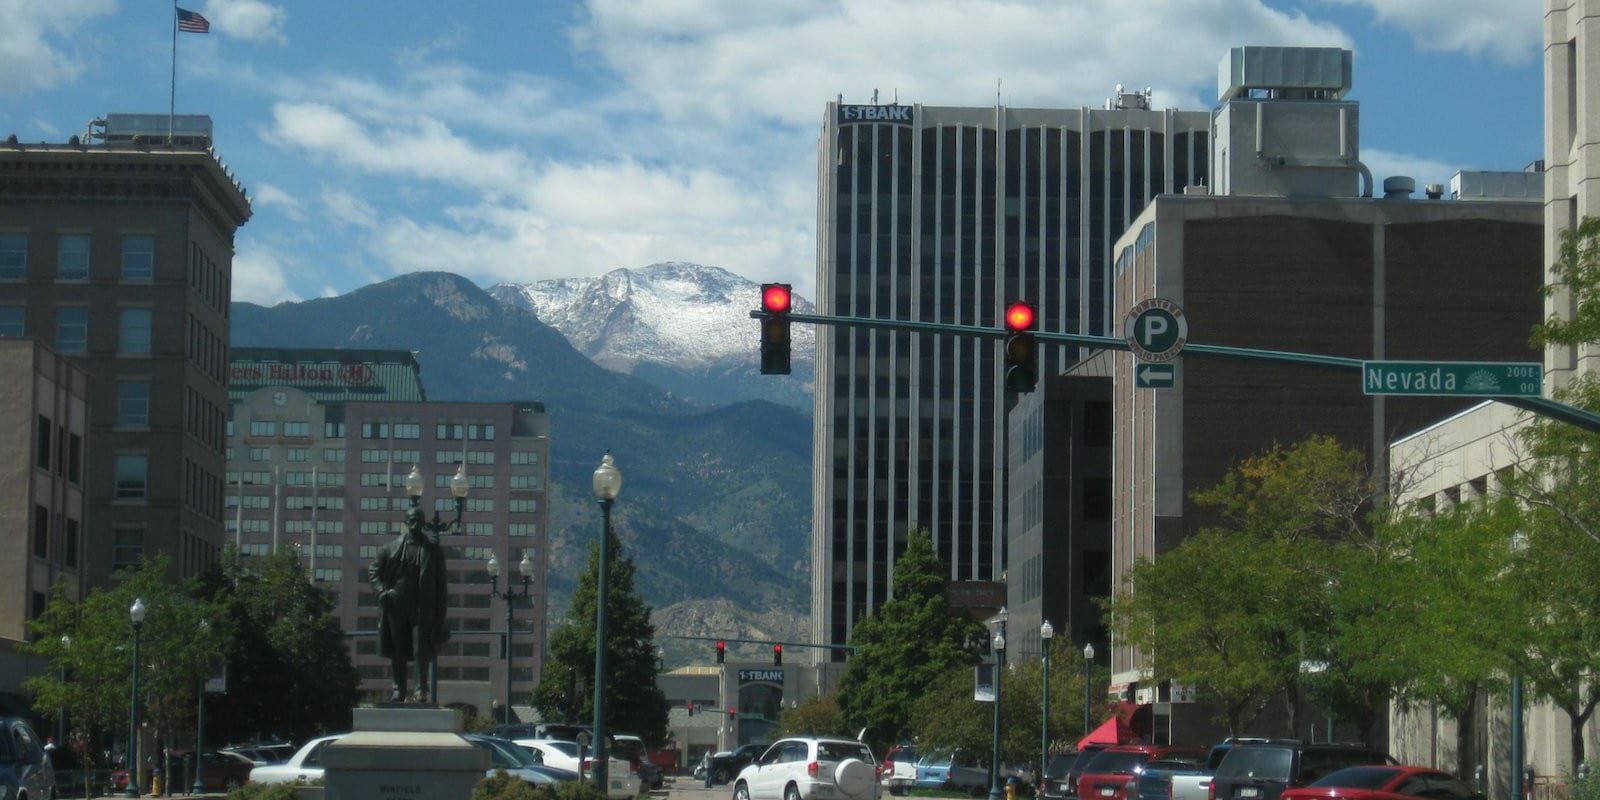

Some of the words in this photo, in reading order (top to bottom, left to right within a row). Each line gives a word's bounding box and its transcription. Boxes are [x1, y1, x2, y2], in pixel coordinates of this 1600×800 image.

[1129, 299, 1182, 319] DOWNTOWN
[1144, 315, 1168, 345] P
[271, 364, 332, 379] Hilton
[1368, 368, 1457, 390] Nevada
